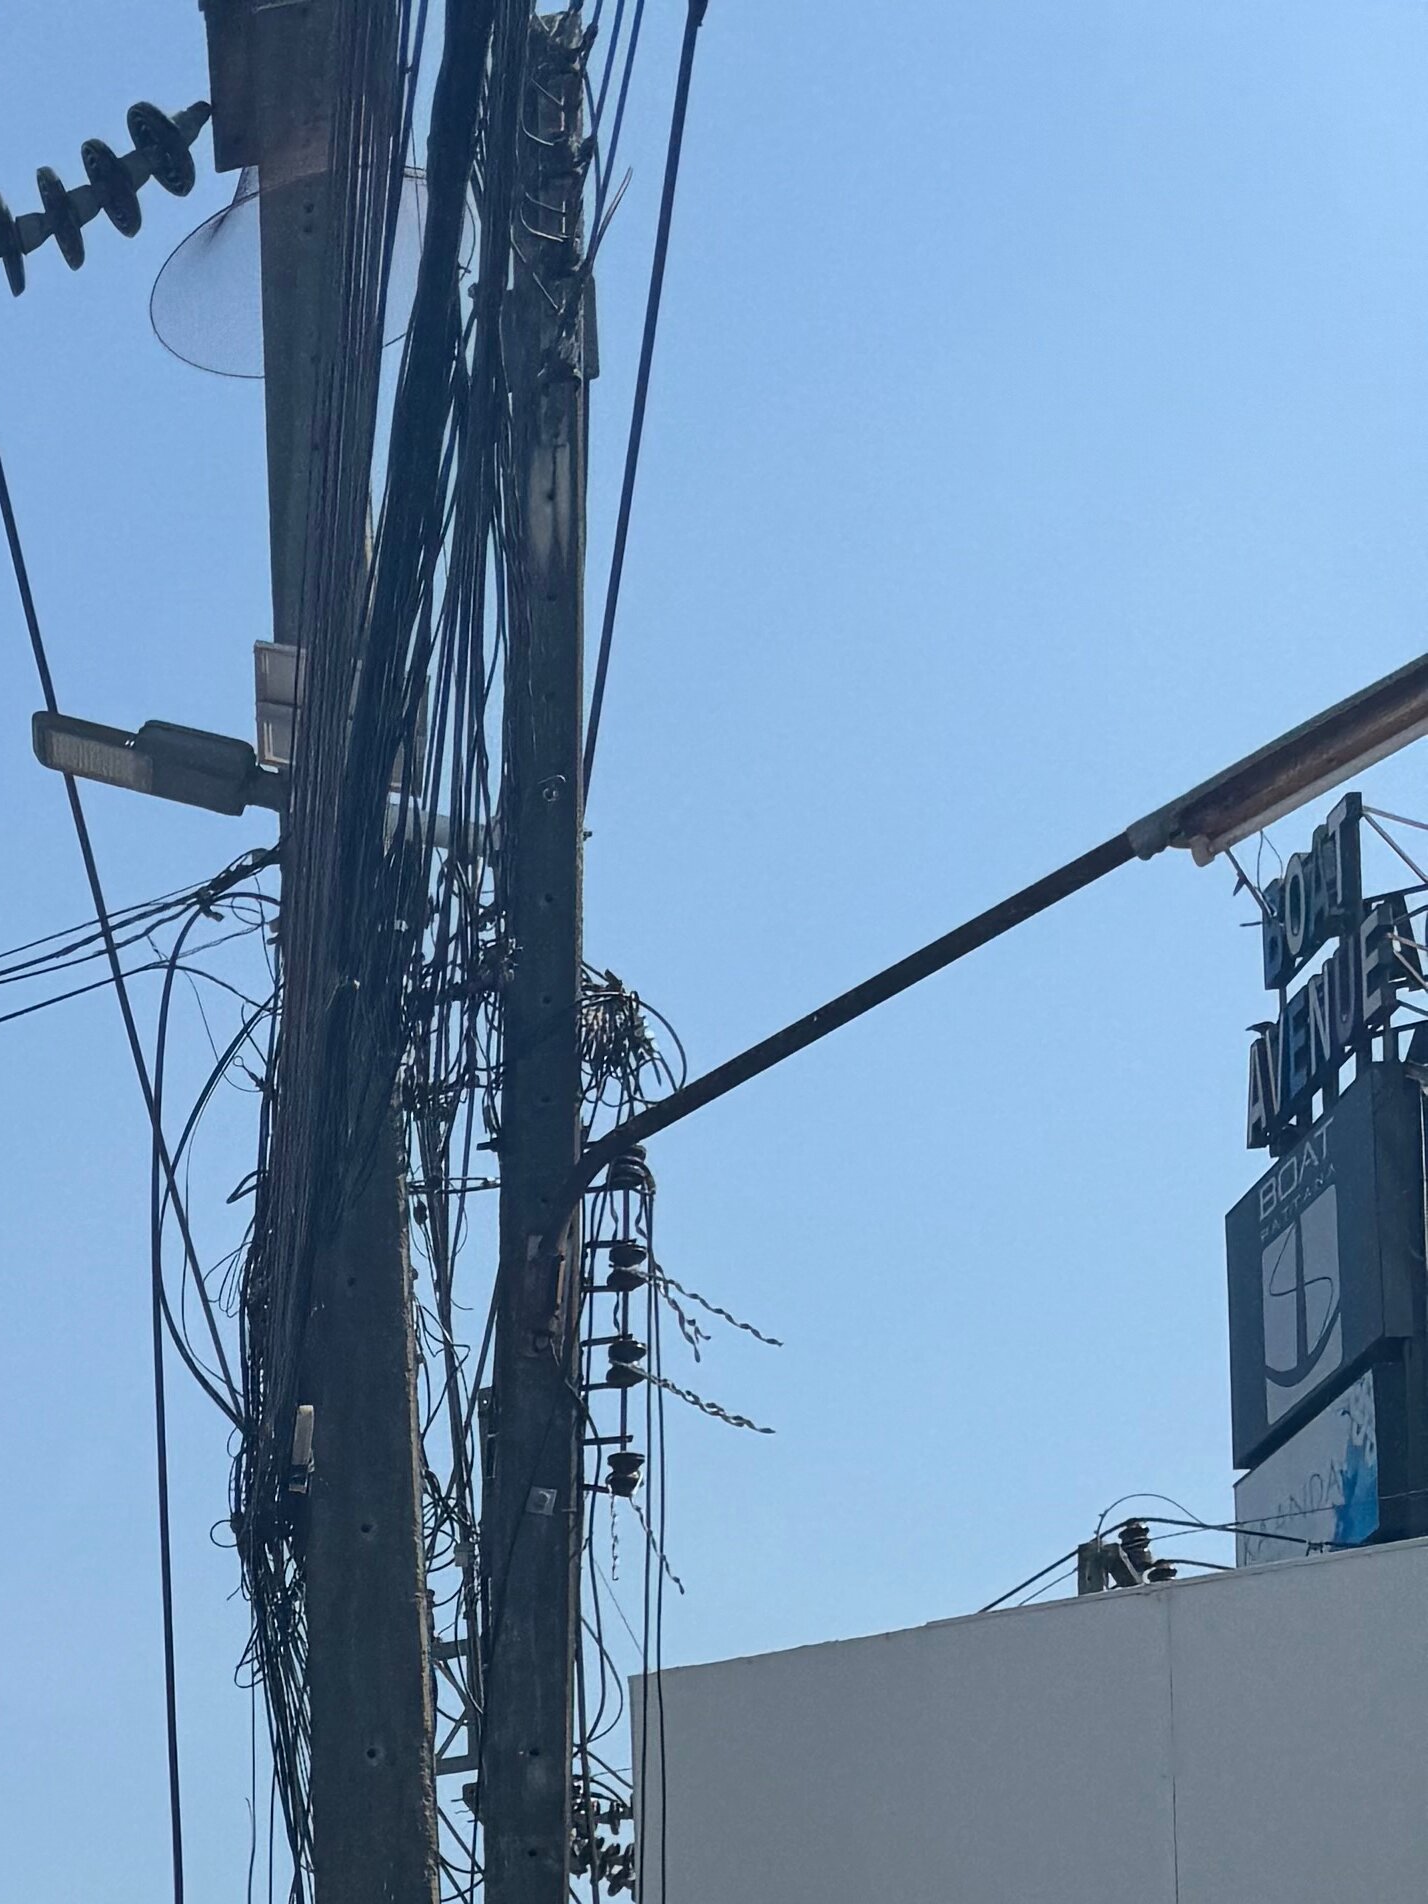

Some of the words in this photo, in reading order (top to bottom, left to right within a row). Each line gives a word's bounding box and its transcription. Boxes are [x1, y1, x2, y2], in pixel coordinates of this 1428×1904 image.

[1262, 792, 1362, 990] BOAT
[1247, 903, 1393, 1149] AVENUE
[1259, 1116, 1334, 1221] BOAT
